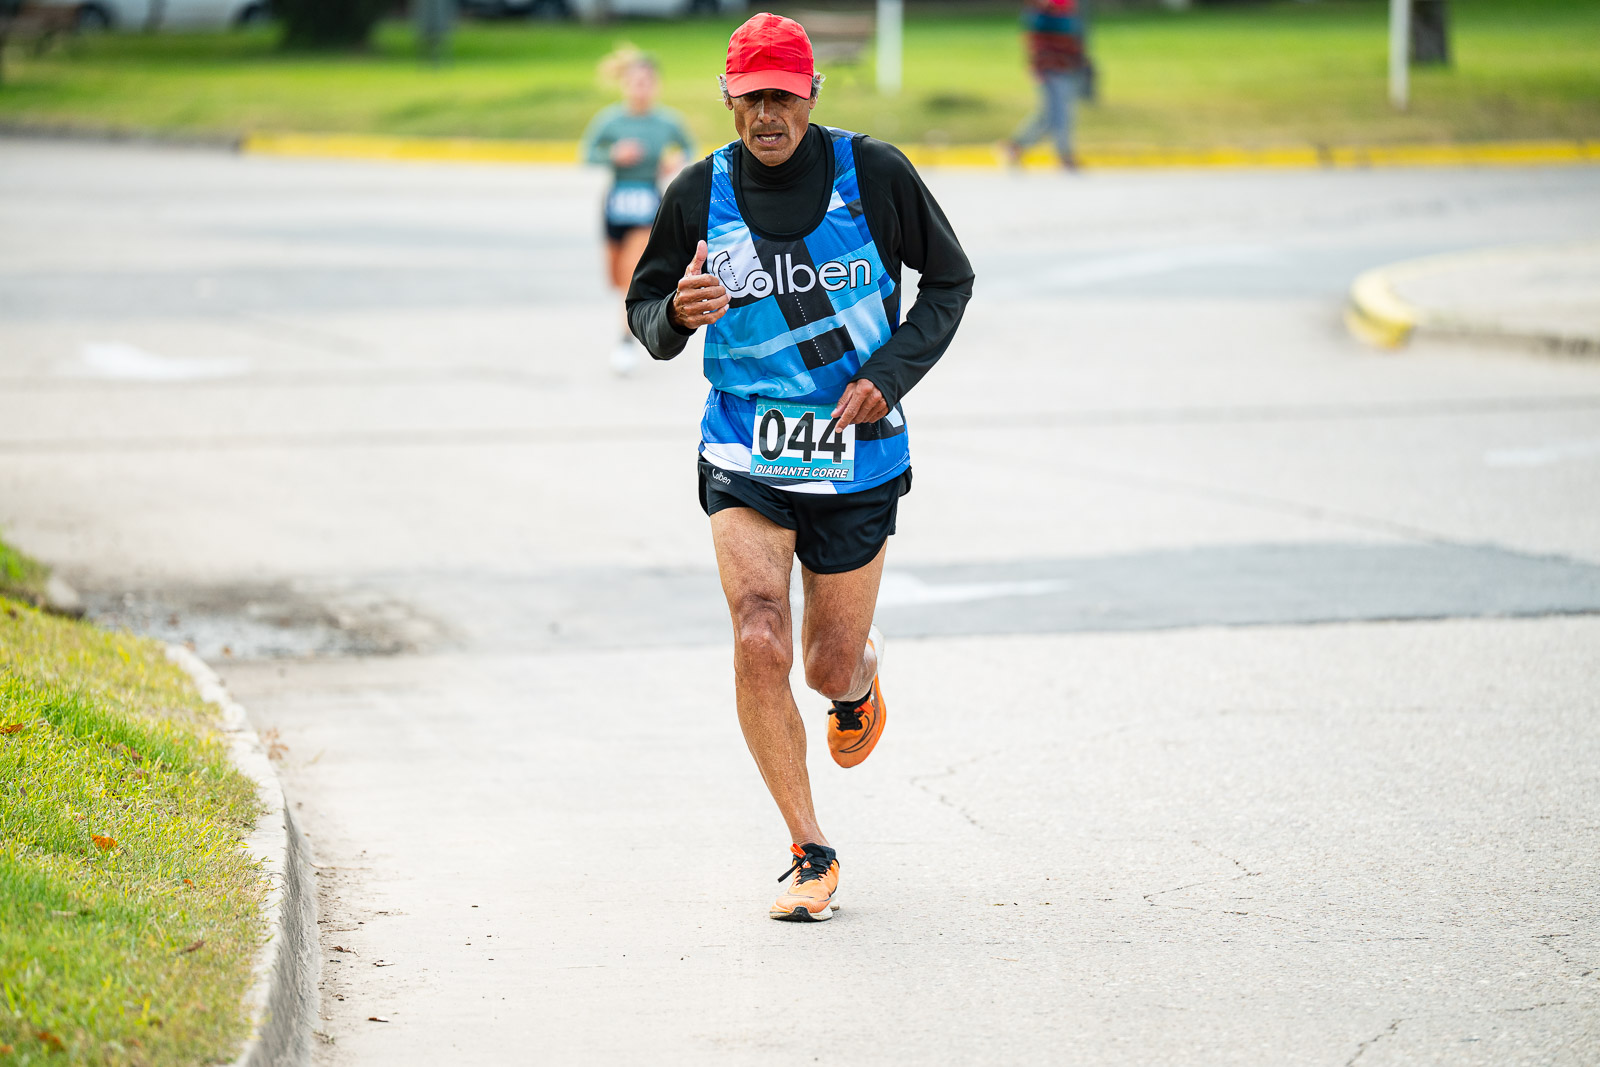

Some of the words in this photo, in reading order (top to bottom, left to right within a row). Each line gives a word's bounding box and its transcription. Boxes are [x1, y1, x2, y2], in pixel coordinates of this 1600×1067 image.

[712, 250, 872, 298] Colben
[759, 408, 846, 463] 044
[754, 464, 810, 478] DIAMANTE
[811, 467, 849, 479] CORRE
